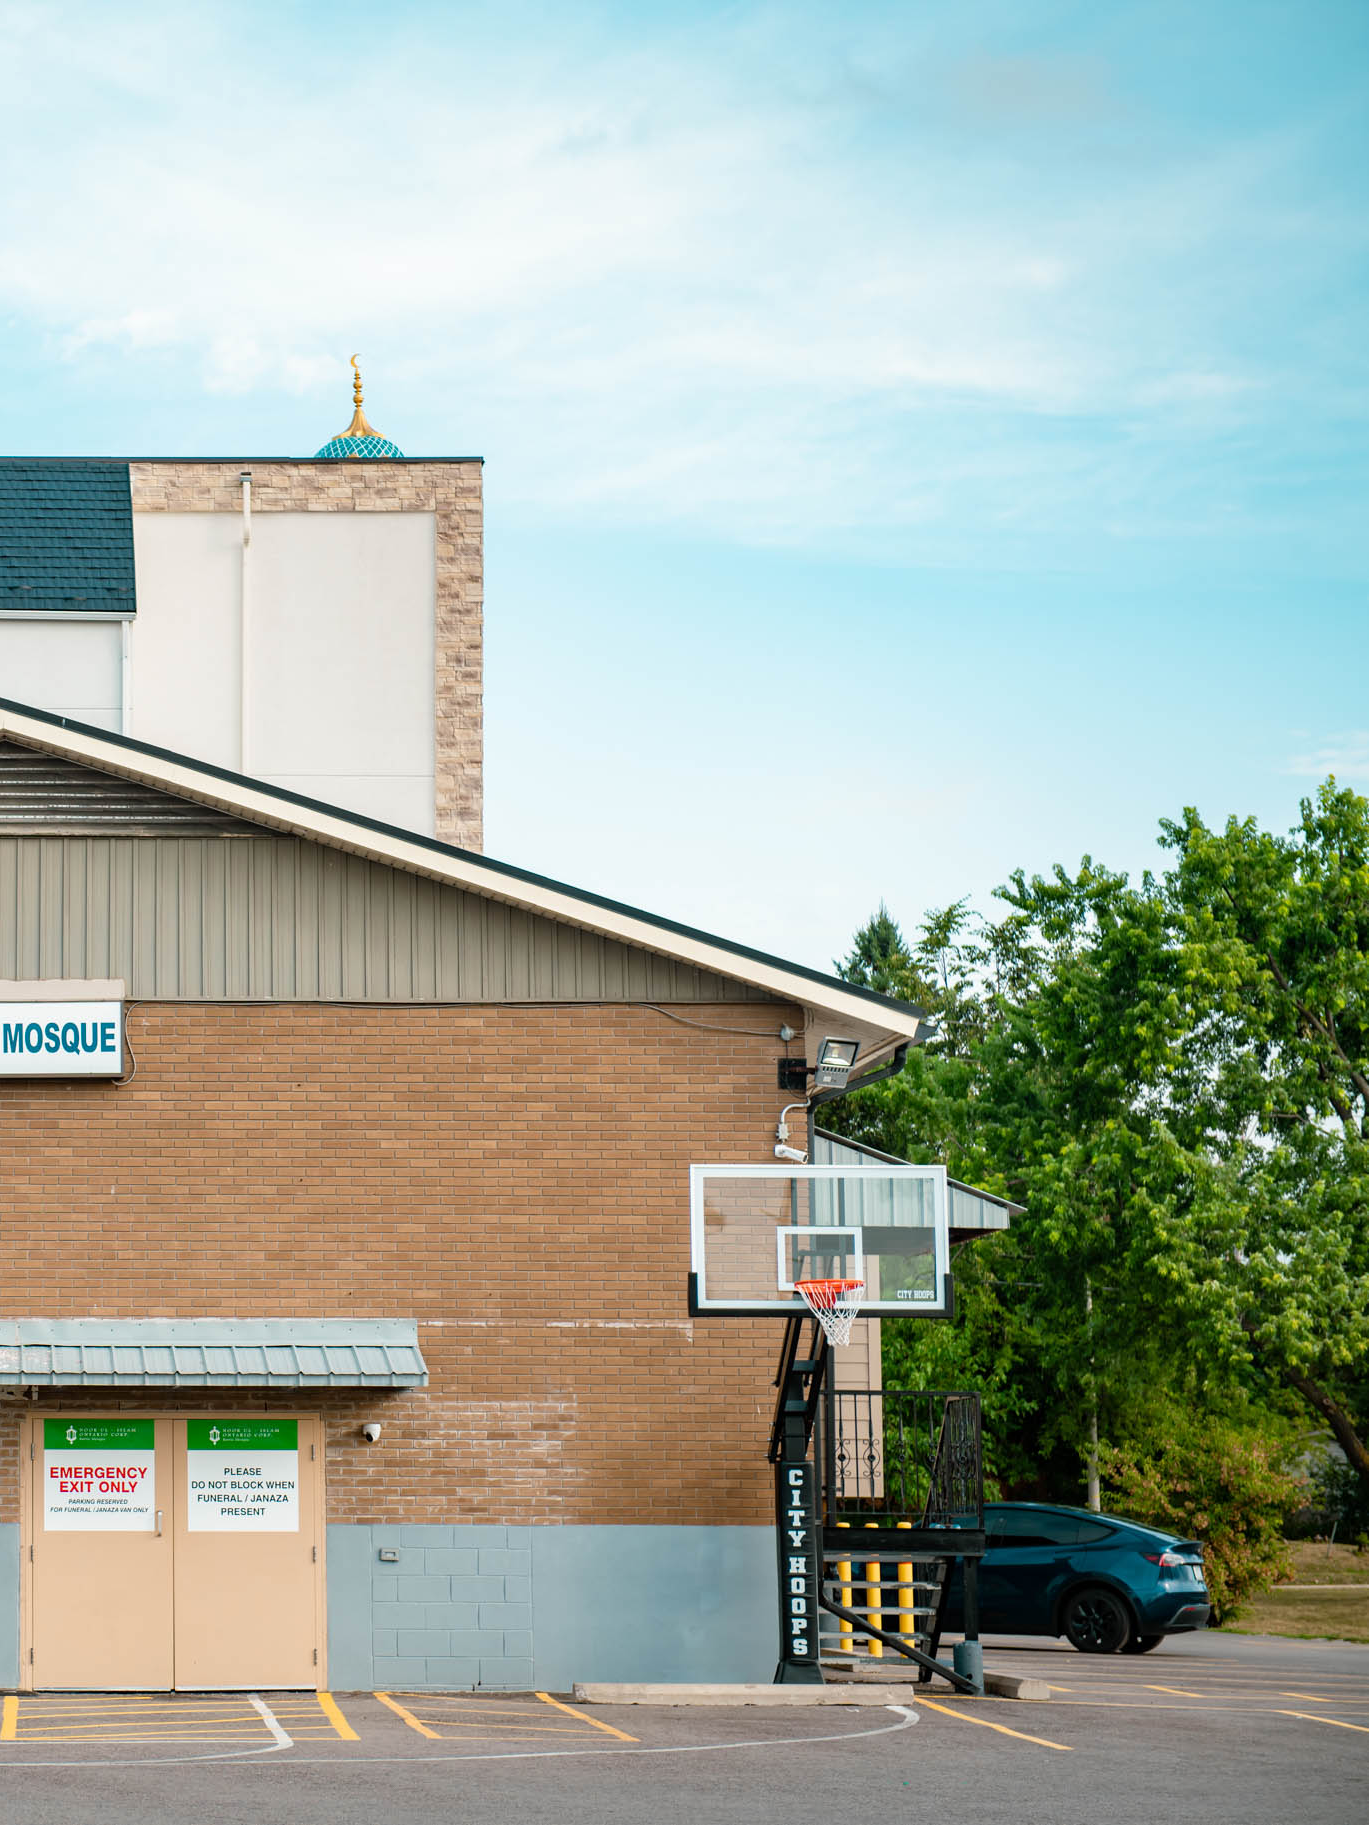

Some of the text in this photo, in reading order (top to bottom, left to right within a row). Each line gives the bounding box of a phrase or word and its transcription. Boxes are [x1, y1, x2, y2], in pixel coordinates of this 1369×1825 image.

[3, 1022, 116, 1055] MOSQUE
[897, 1290, 935, 1299] CITY HOOPS
[50, 1467, 148, 1479] EMERGENCY
[224, 1468, 262, 1476] PLEASE
[60, 1481, 138, 1493] EXIT ONLY
[191, 1481, 295, 1489] DO NOT BLOCK WHEN
[221, 1508, 265, 1516] PRESENT
[788, 1469, 806, 1547] CITY
[789, 1557, 808, 1655] HOOPS
